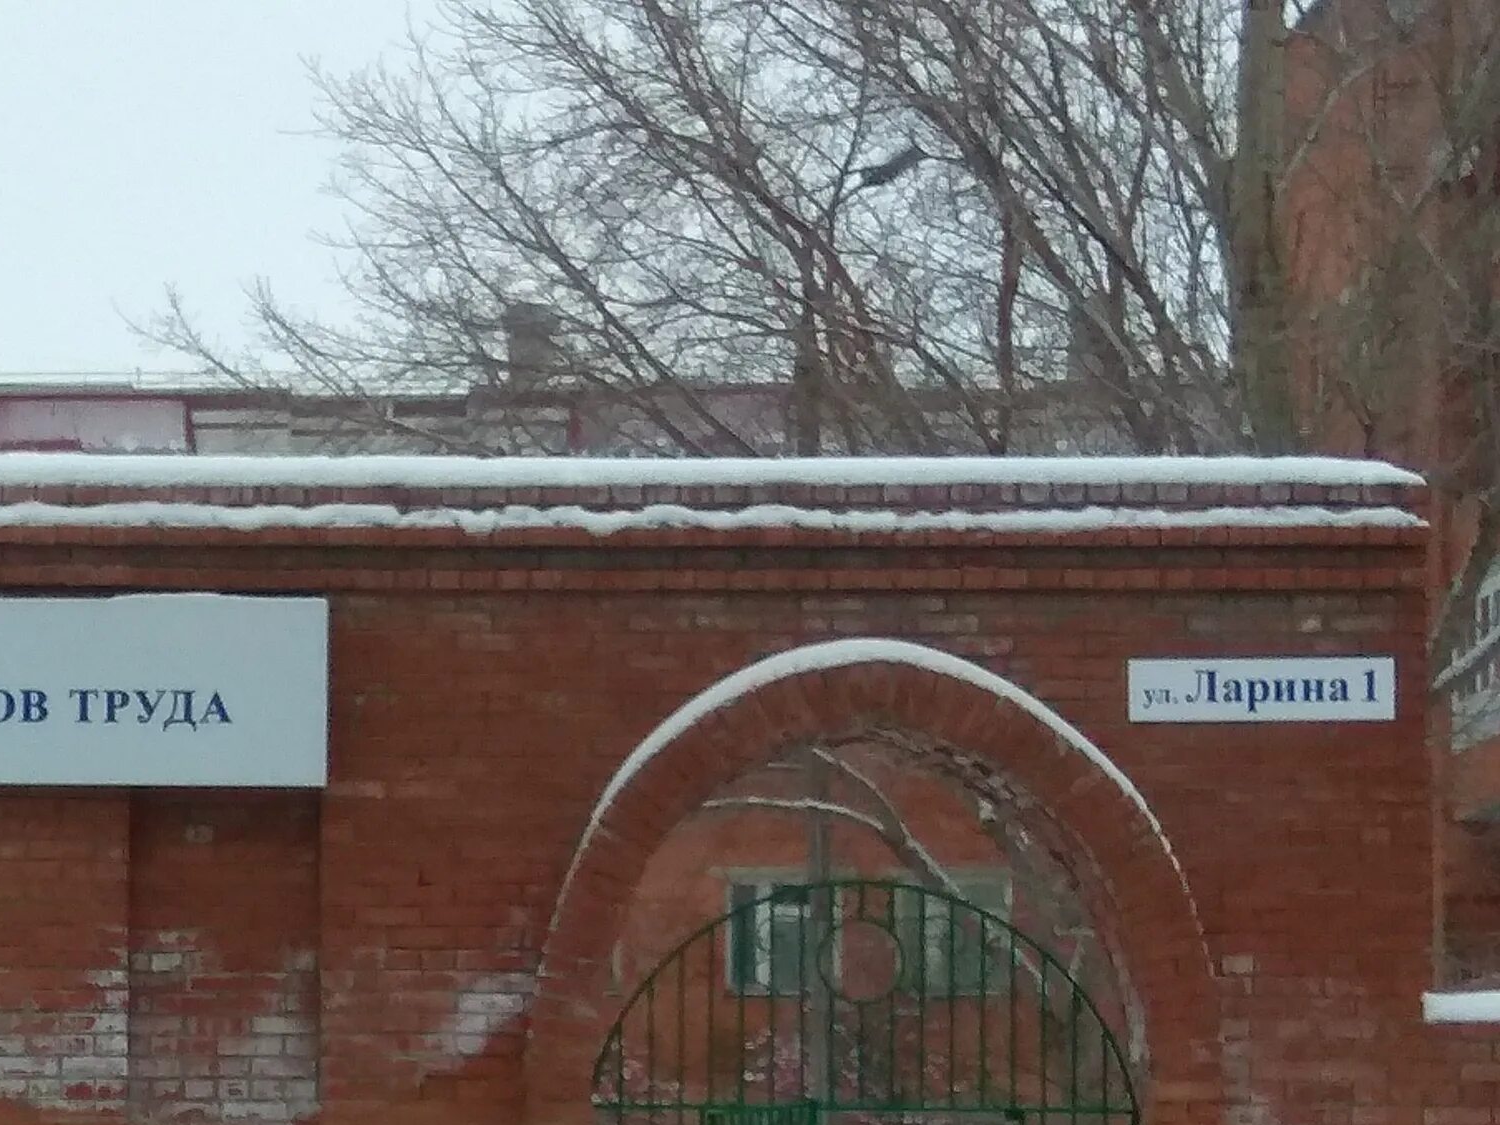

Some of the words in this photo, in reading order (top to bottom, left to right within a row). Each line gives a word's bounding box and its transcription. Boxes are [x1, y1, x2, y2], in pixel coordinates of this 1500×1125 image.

[68, 689, 234, 732] ТРУДА
[1185, 667, 1350, 712] Ларина
[1363, 667, 1379, 702] 1
